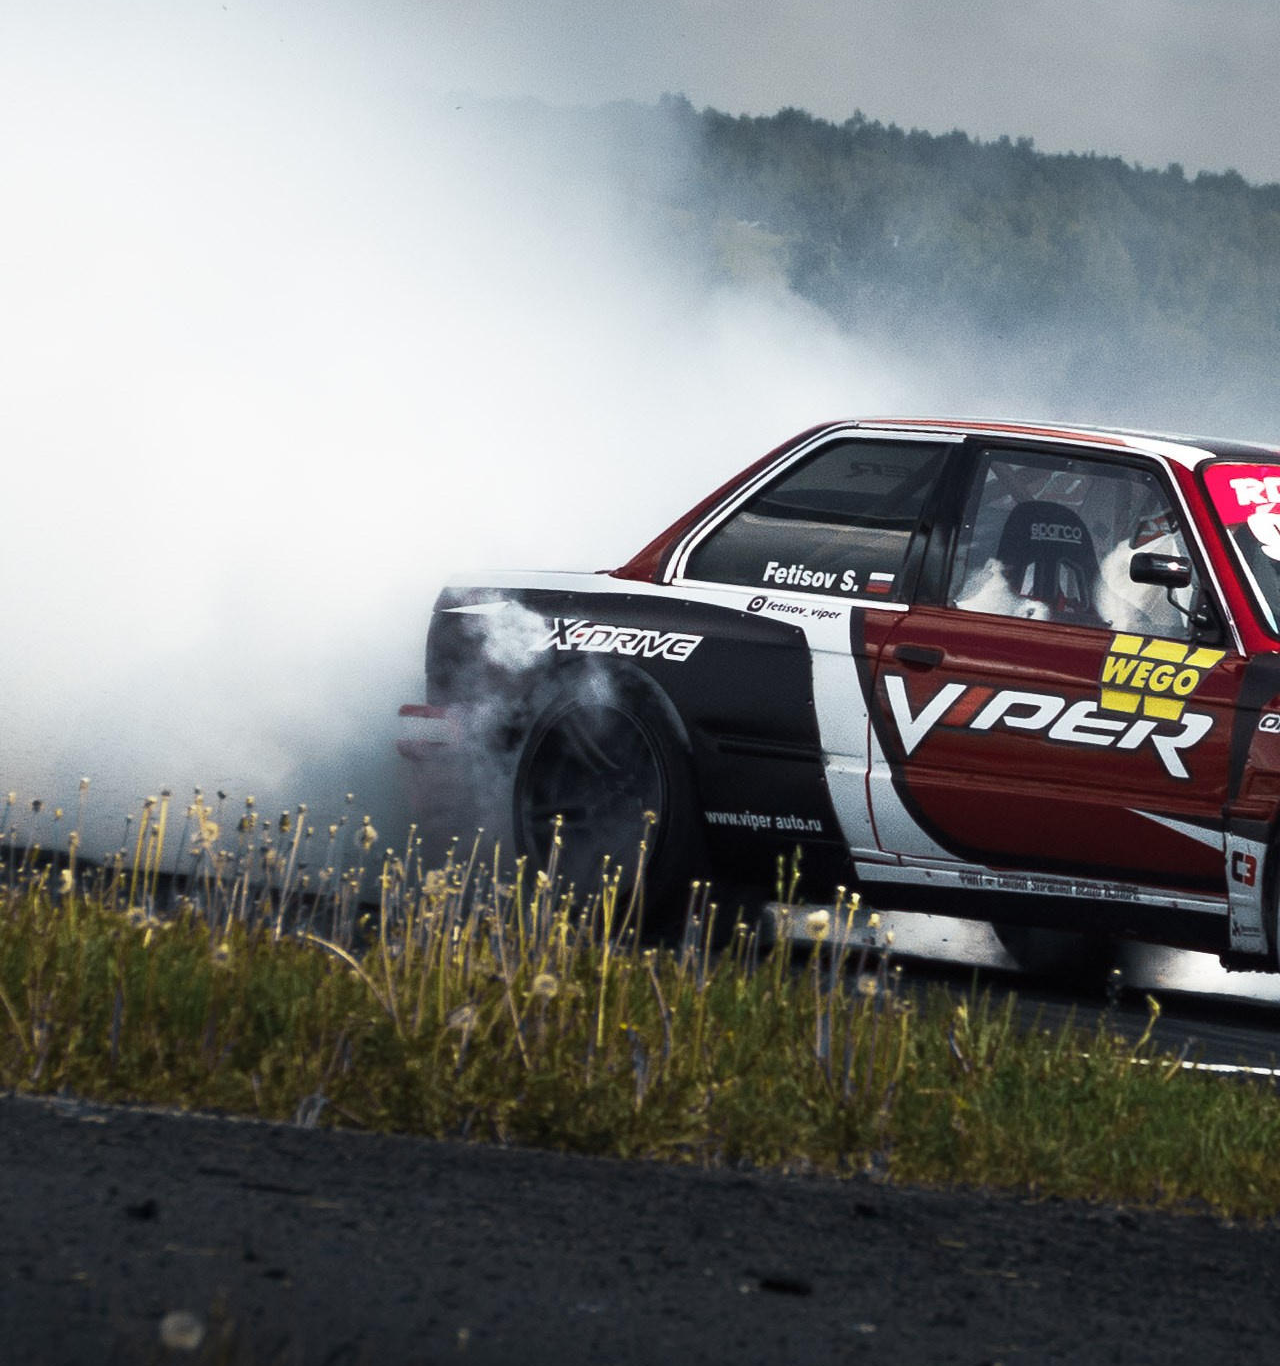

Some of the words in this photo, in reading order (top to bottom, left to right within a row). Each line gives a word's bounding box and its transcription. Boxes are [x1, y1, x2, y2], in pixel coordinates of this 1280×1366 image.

[1031, 523, 1082, 540] sparco
[763, 561, 837, 588] Fetisov
[840, 570, 859, 592] S.
[766, 601, 842, 620] fetisov_viper
[530, 617, 704, 662] X-DRIVE
[1101, 656, 1200, 696] WEGO
[884, 675, 1213, 779] VIPER
